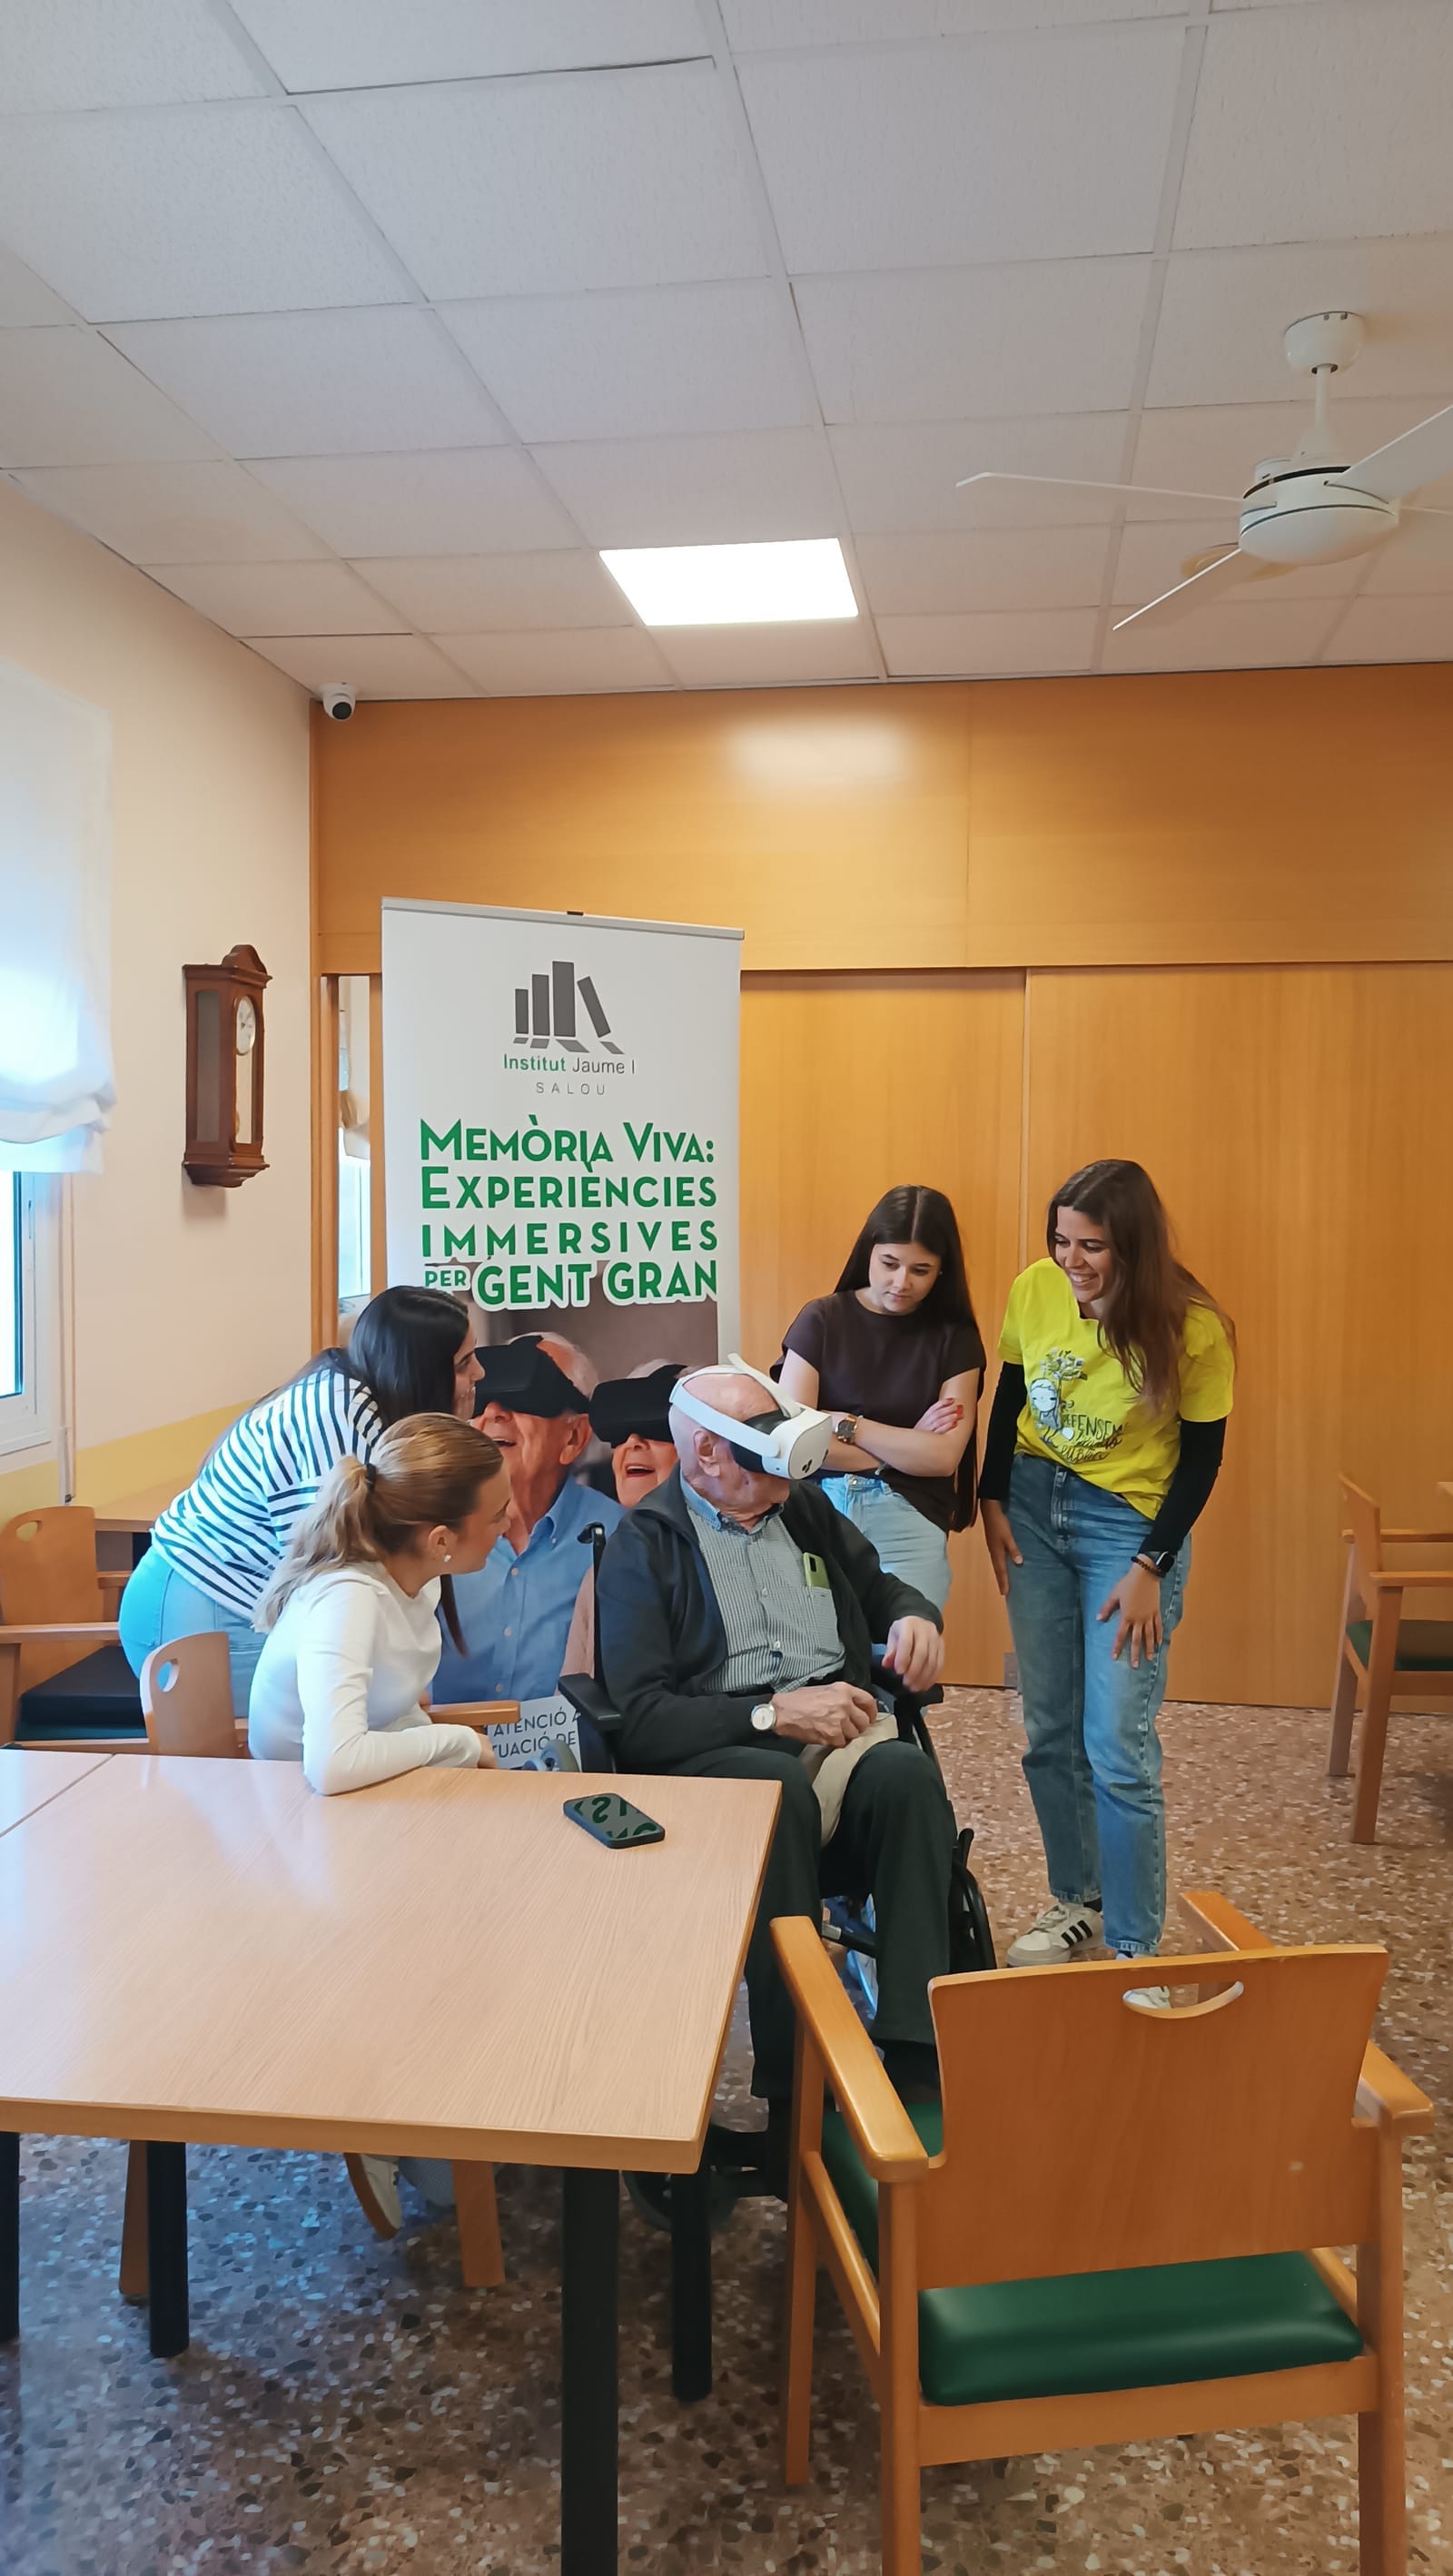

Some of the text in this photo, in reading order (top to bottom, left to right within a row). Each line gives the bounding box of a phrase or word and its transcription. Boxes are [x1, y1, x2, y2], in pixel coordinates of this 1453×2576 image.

[503, 1053, 635, 1074] Institut Jaume I
[536, 1081, 605, 1095] SALOU
[420, 1114, 714, 1163] MEMÒRIA VIVA:
[421, 1162, 717, 1209] EXPERIÈNCIES
[422, 1219, 718, 1257] IMMERSIVES
[425, 1259, 717, 1306] PER GENT GRAN
